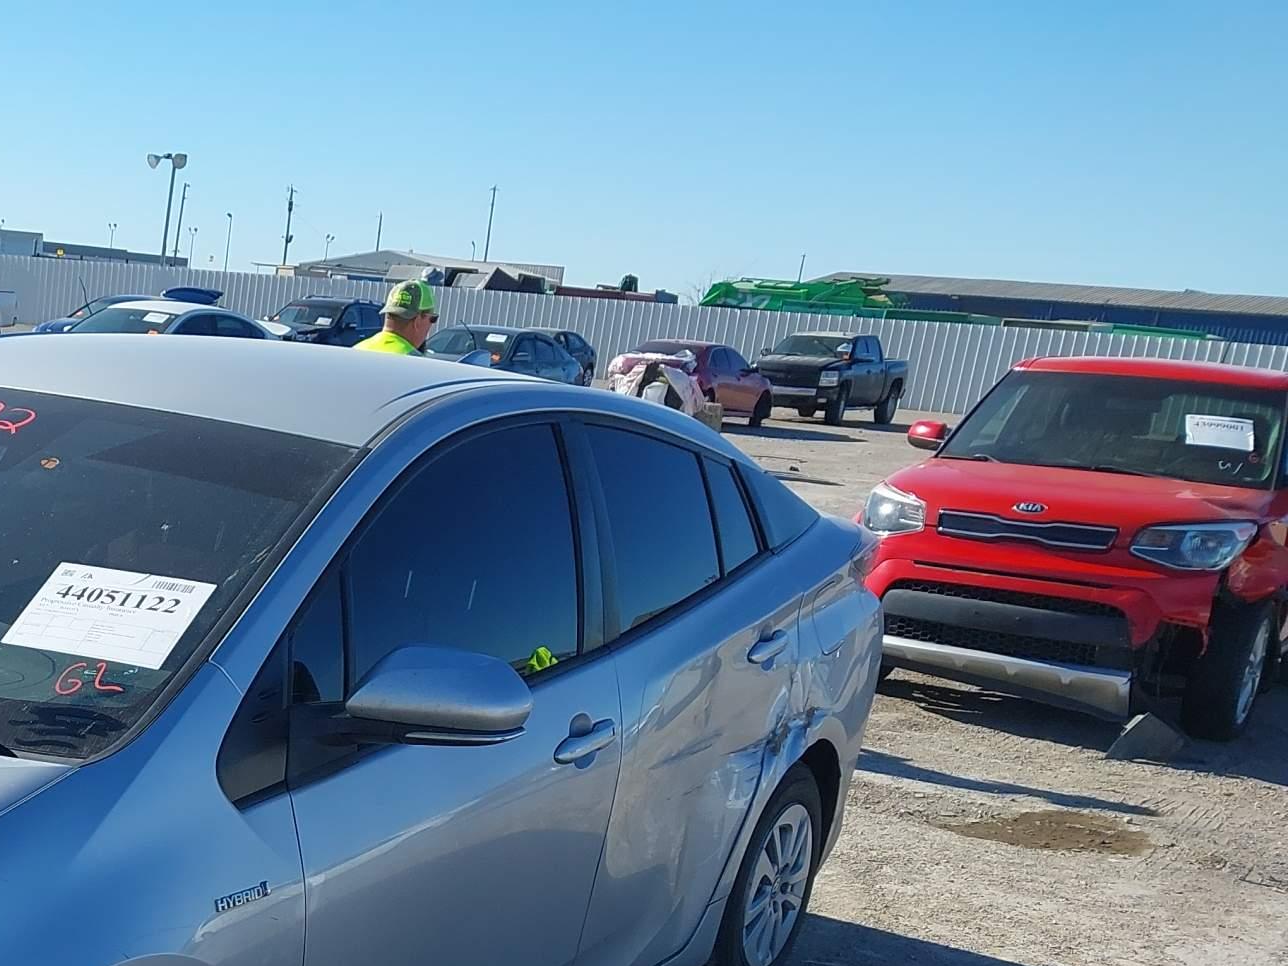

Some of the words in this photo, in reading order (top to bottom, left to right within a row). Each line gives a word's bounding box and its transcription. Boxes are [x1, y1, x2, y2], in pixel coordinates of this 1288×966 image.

[1018, 502, 1042, 512] KIA
[55, 583, 182, 614] 44051122
[216, 885, 263, 912] HYBRID
